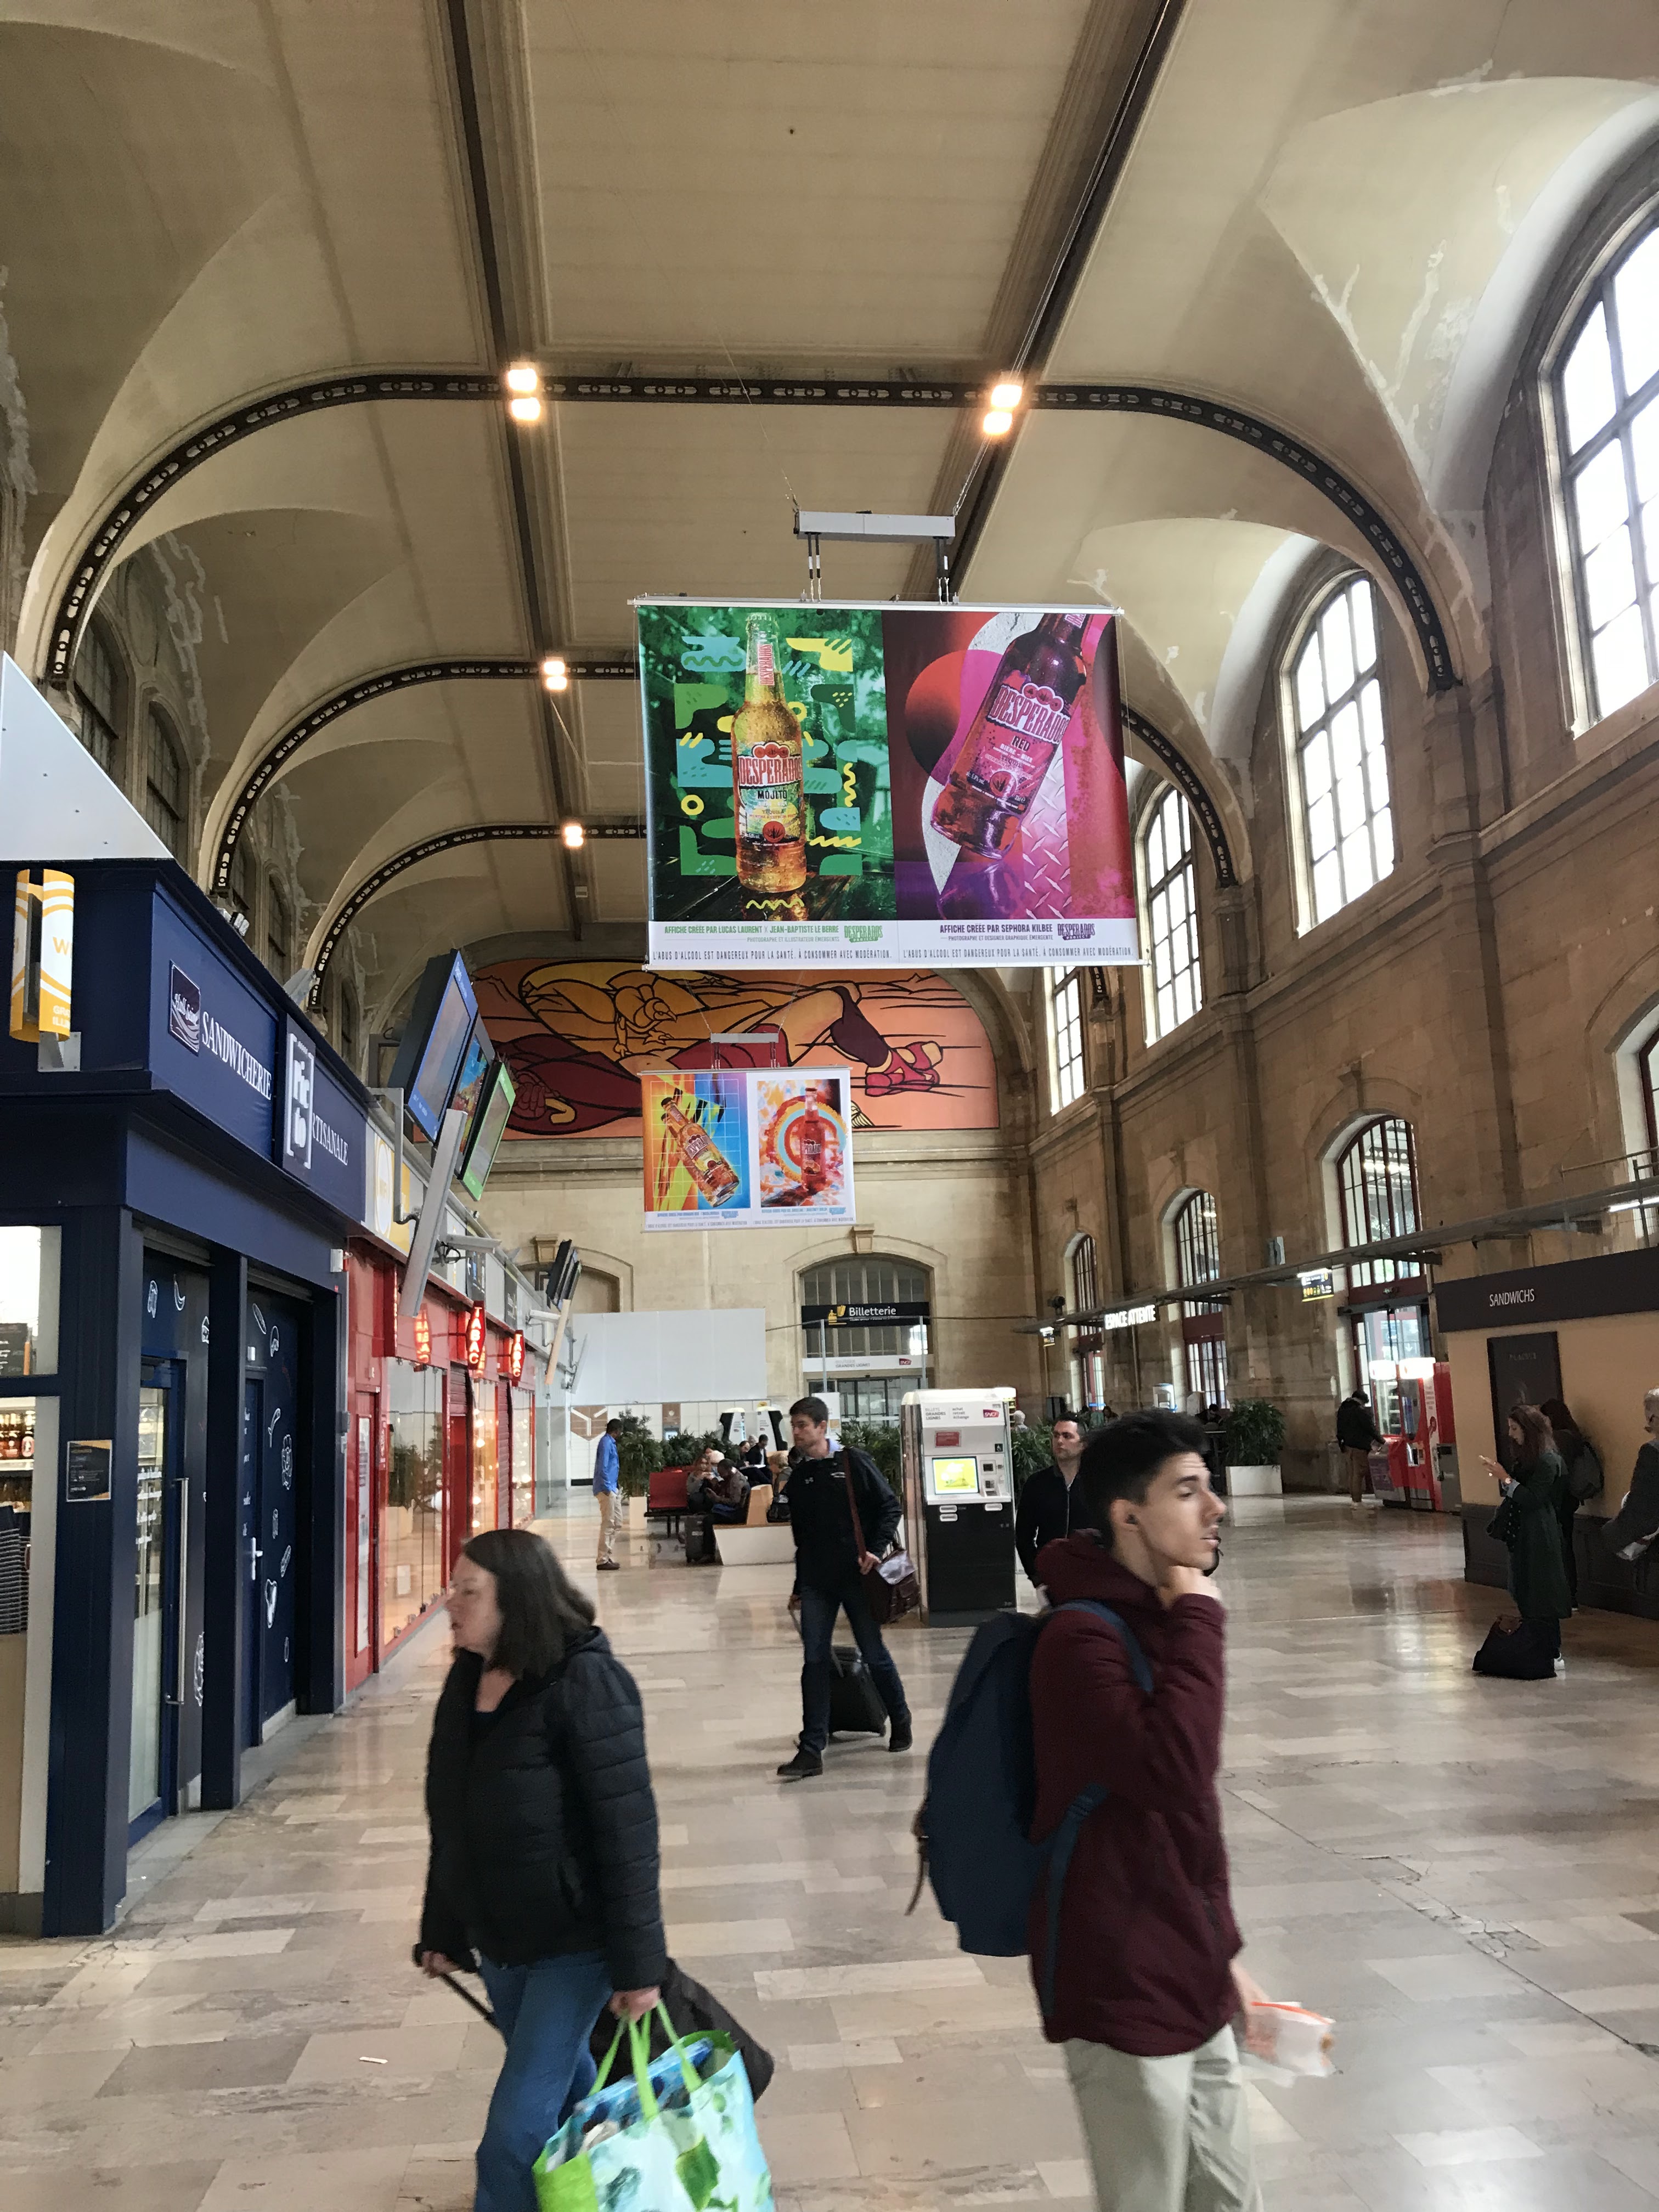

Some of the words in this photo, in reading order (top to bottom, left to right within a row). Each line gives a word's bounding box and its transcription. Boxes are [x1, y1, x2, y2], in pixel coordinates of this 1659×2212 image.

[1011, 736, 1031, 752] RED
[739, 757, 802, 785] DESPERADOS
[758, 790, 787, 799] MOJITO
[844, 926, 883, 939] DESPERADOS
[940, 924, 965, 933] AFFICHE
[988, 924, 1000, 933] PAR
[1001, 924, 1030, 933] SEPHORA
[1032, 924, 1053, 932] KILBEE
[1058, 923, 1096, 936] DESPERADOS
[653, 951, 673, 960] L'ABUS
[675, 951, 702, 960] D'ALCOOL
[704, 951, 714, 960] EST
[717, 951, 748, 960] DANGEREUX
[752, 951, 765, 960] POUR
[768, 951, 774, 959] LA
[804, 950, 837, 959] CONSOMMER
[840, 950, 853, 958] AVEC
[903, 950, 922, 958] L'ABUS
[924, 950, 950, 958] D'ALCOOL
[964, 949, 995, 957] DANGEREUX
[997, 949, 1011, 957] POUR
[1013, 949, 1020, 957] LA
[1049, 948, 1080, 956] CONSOMMER
[1083, 947, 1096, 956] AVEC
[202, 1011, 272, 1101] SANDWICHERIE
[312, 1111, 348, 1166] RTISANALE
[1489, 1288, 1535, 1307] SANDWICHS
[849, 1306, 896, 1317] Billetterie
[1128, 1304, 1156, 1325] ATTENTE
[469, 1307, 483, 1364] TABAC
[512, 1334, 522, 1377] TABAC
